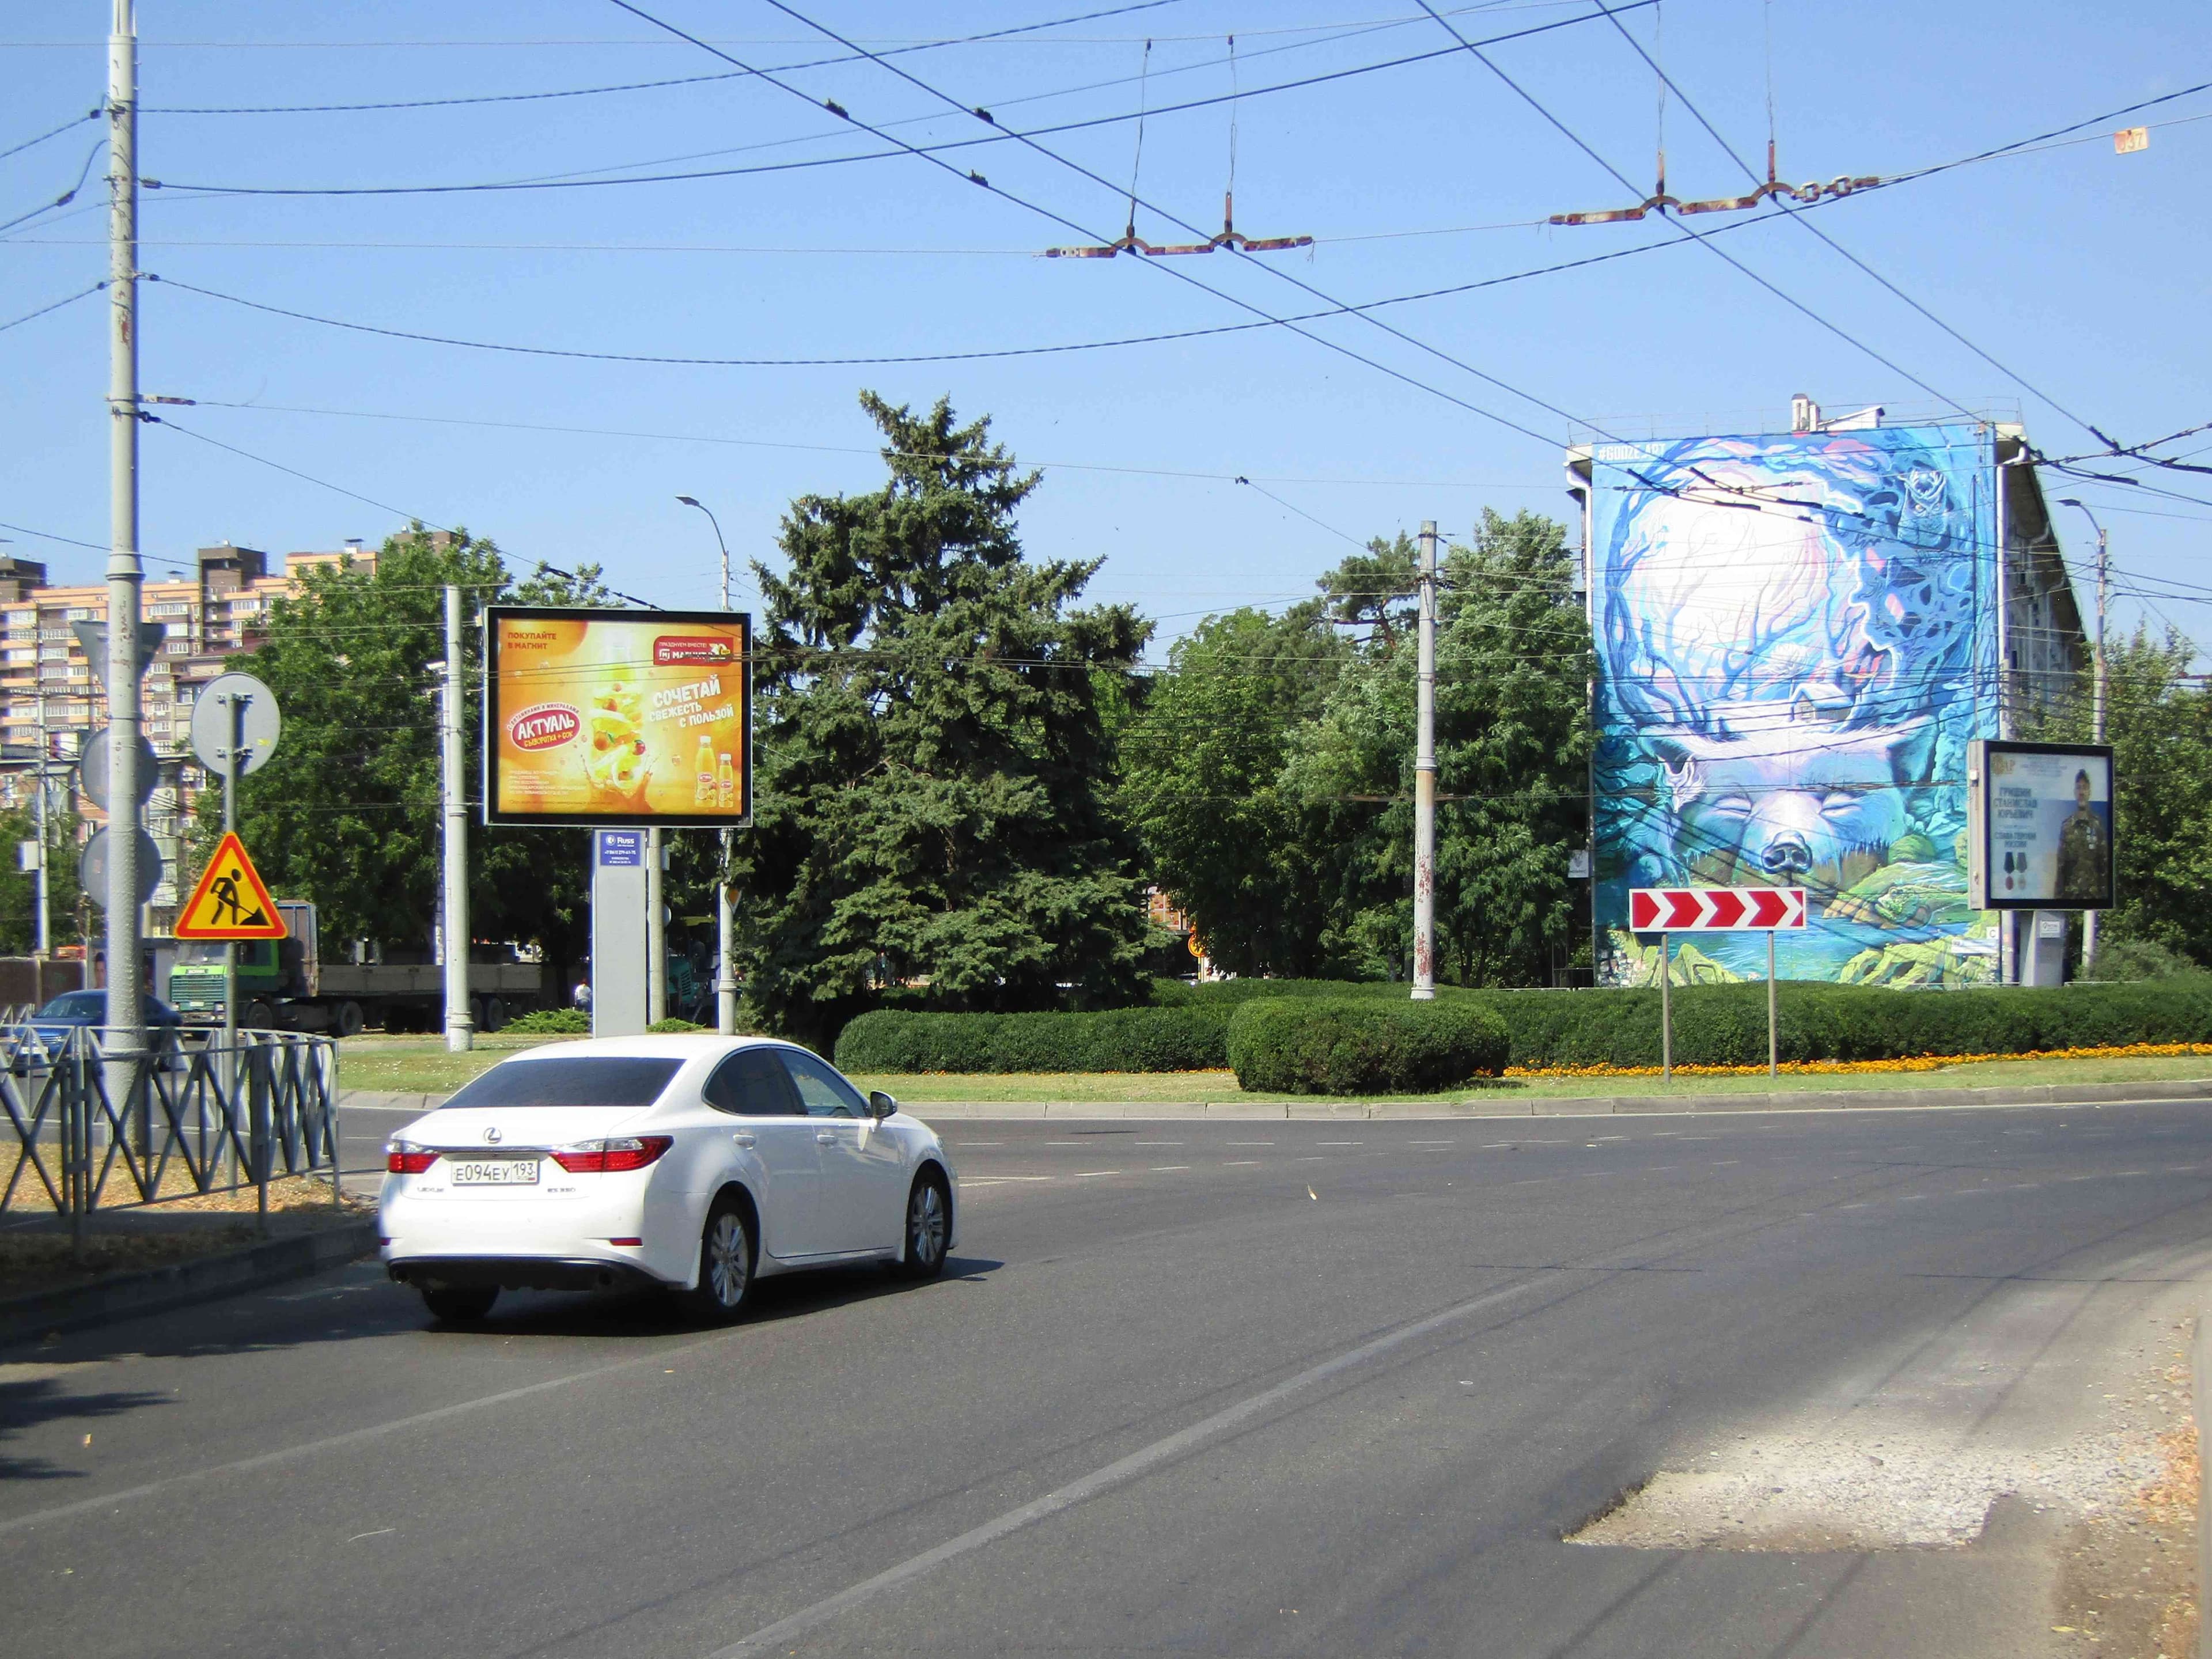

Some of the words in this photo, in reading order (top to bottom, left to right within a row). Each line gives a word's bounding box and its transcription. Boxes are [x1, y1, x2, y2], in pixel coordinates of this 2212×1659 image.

[507, 631, 557, 640] ПОКУПАЙТЕ
[653, 674, 721, 707] СОЧЕТАЙ
[649, 702, 702, 722] СВЕЖЕСТЬ
[680, 718, 686, 728] С
[690, 703, 734, 726] ПОЛЬЗОЙ
[517, 714, 575, 740] АКТУАЛЬ
[524, 734, 557, 747] СЫВОРОТКА
[562, 730, 573, 740] СОК
[513, 1162, 533, 1176] 193
